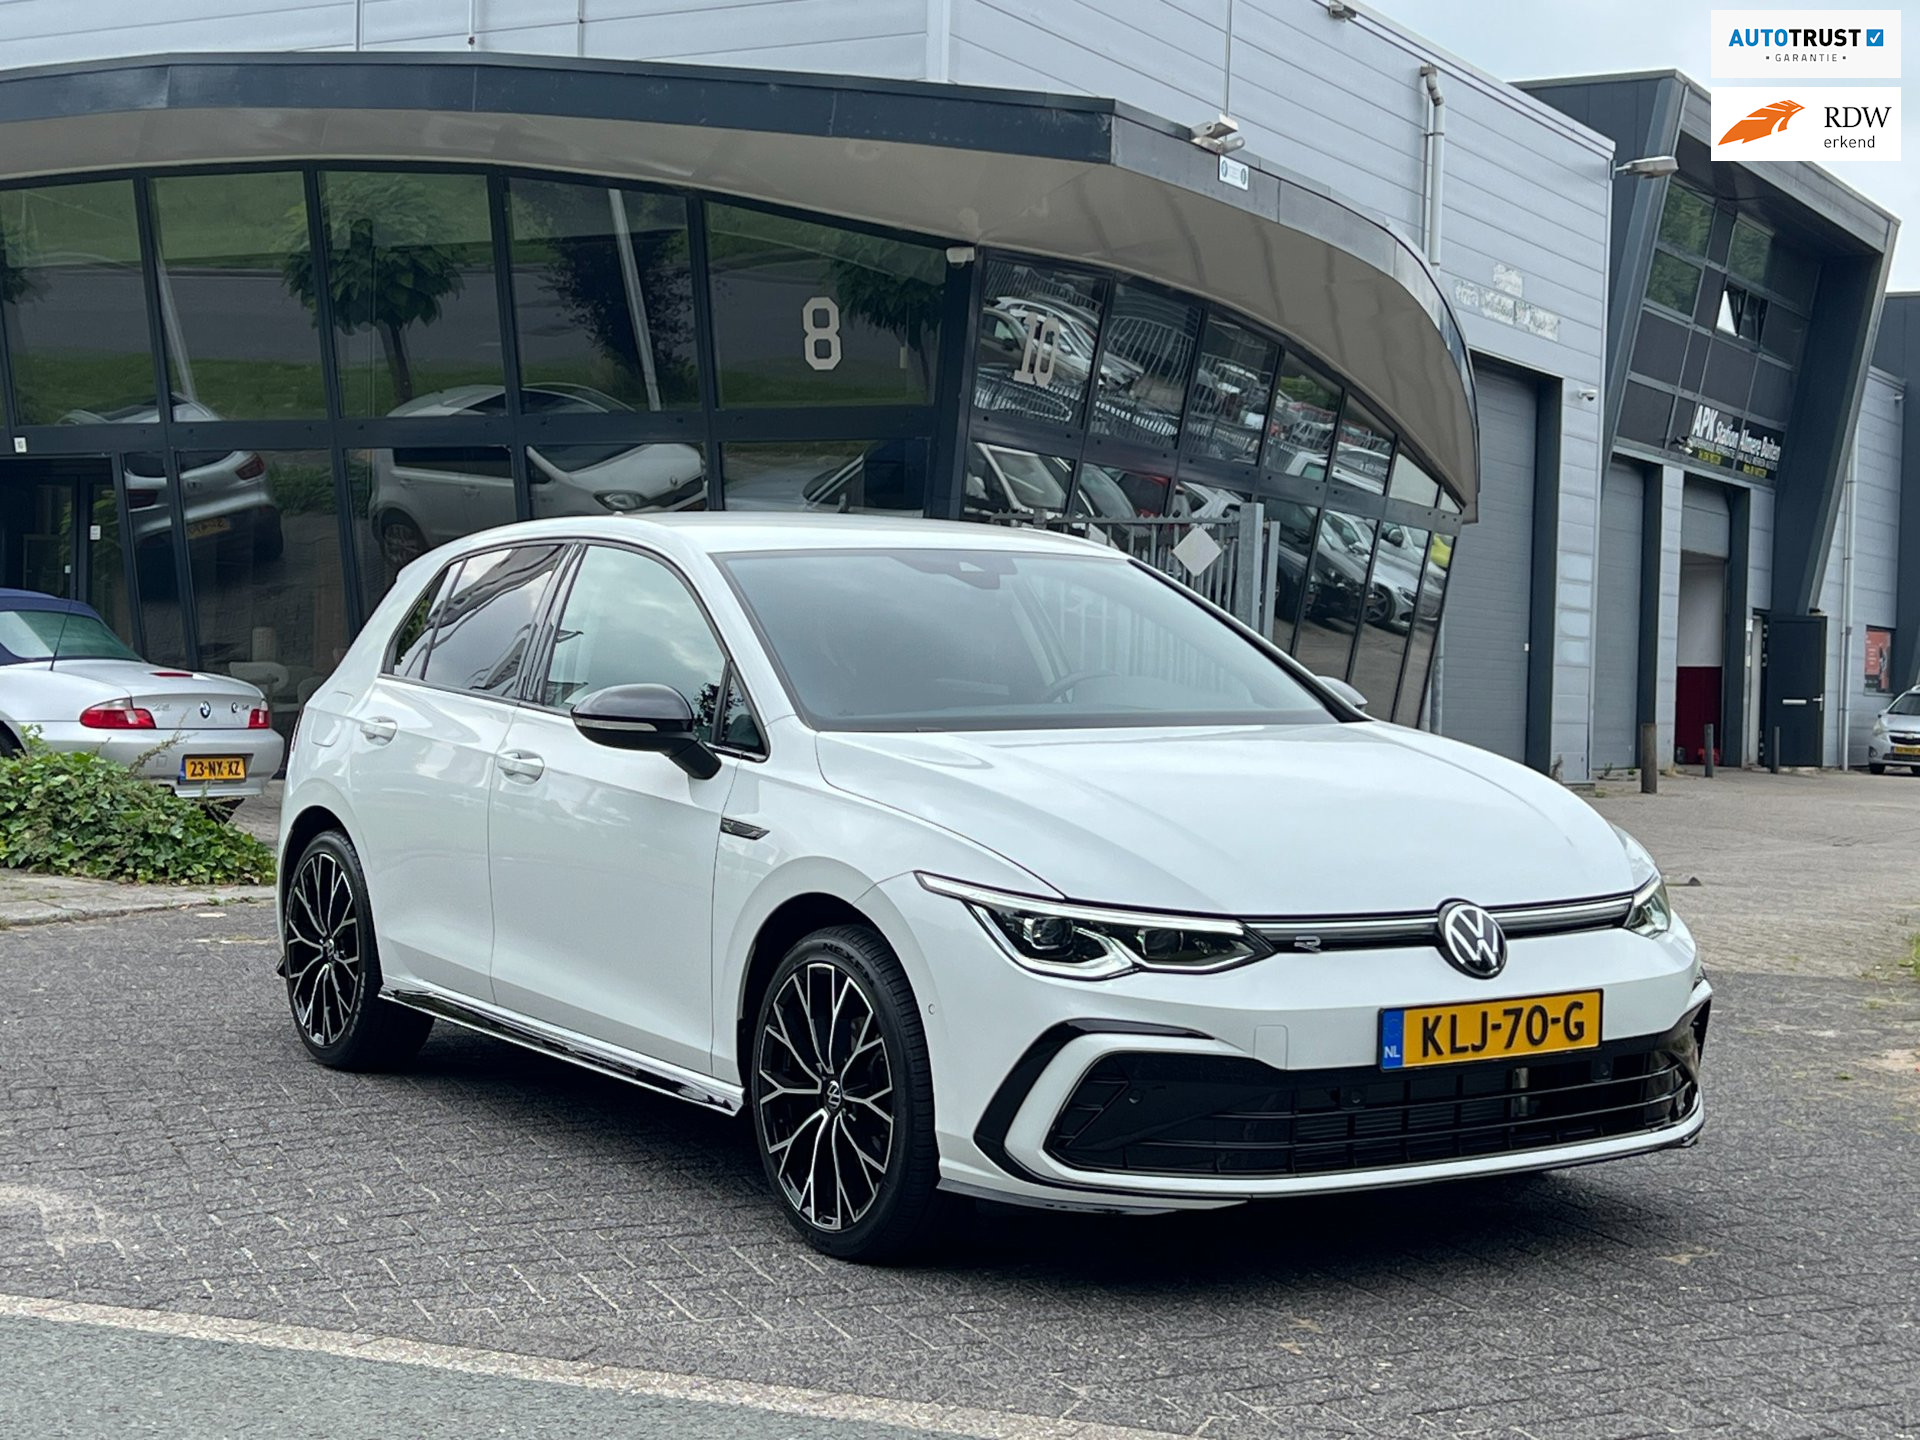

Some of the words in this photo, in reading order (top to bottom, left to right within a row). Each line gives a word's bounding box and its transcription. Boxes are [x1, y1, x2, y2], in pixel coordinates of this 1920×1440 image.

[802, 297, 841, 370] 8
[1014, 311, 1060, 386] 10
[1691, 404, 1719, 441] APK
[1384, 1045, 1400, 1059] NL
[1421, 1001, 1585, 1058] KLJ-70-G
